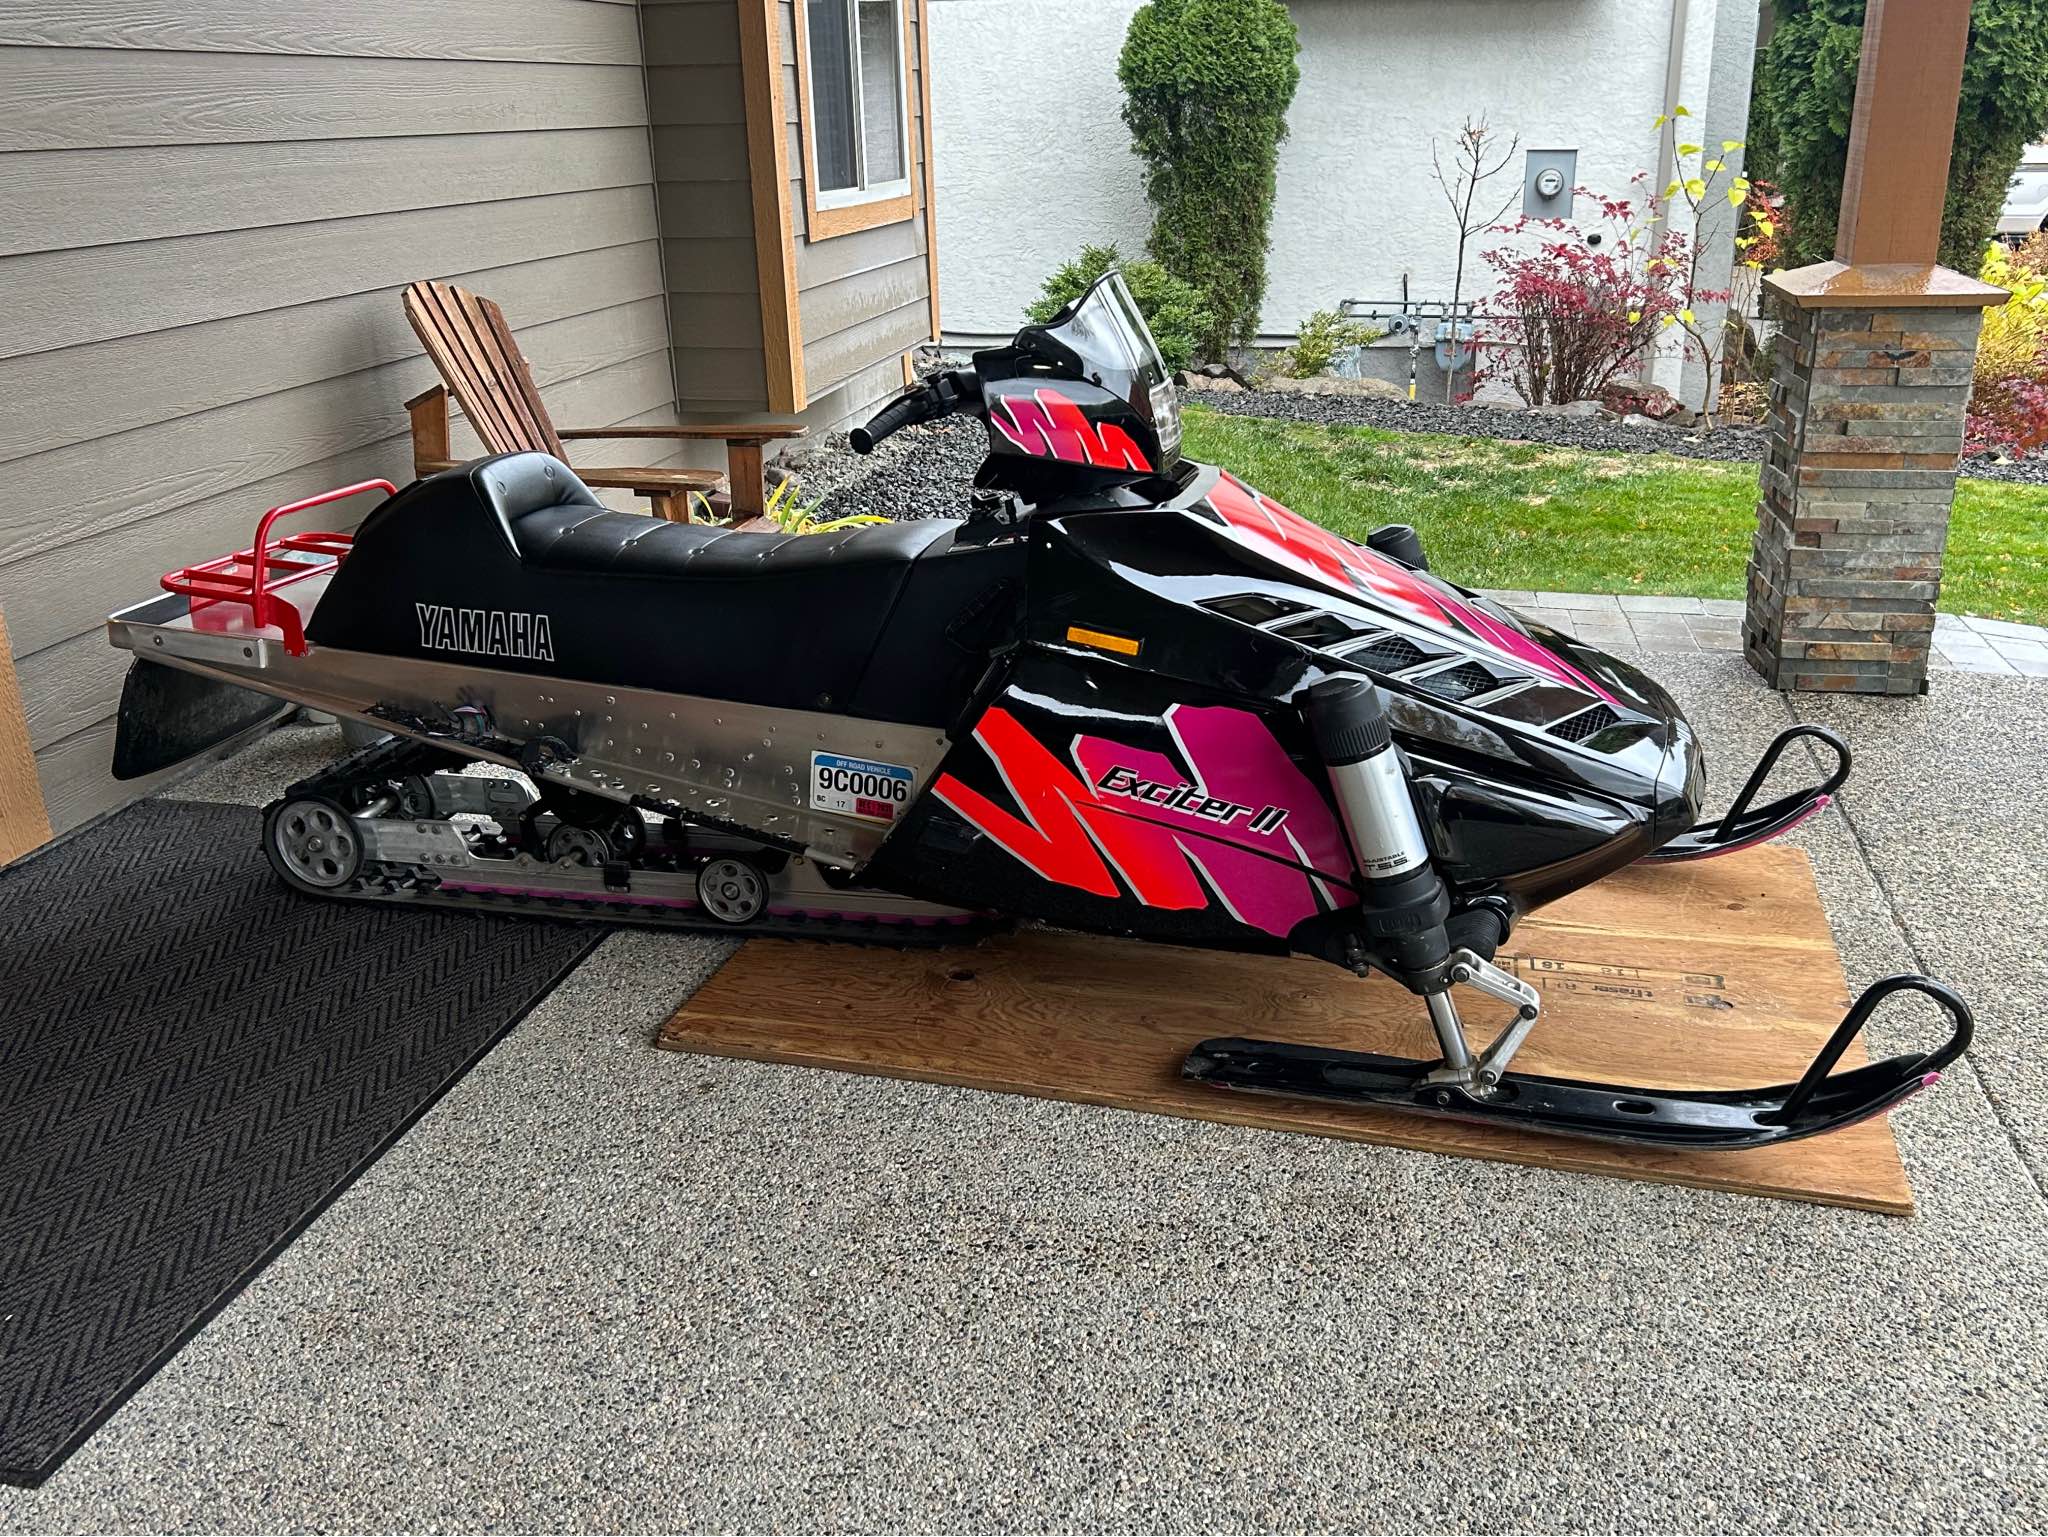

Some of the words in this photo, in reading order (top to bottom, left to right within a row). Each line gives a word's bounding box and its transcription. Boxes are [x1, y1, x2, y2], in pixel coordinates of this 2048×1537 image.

[416, 603, 555, 662] YAMAHA
[836, 759, 847, 768] OFF
[849, 762, 865, 771] ROAD
[866, 764, 892, 776] VEHICLE
[818, 767, 907, 802] 9C0006
[816, 794, 826, 802] BC
[836, 800, 846, 808] 17
[1095, 764, 1253, 825] Exciter
[1247, 804, 1290, 836] II
